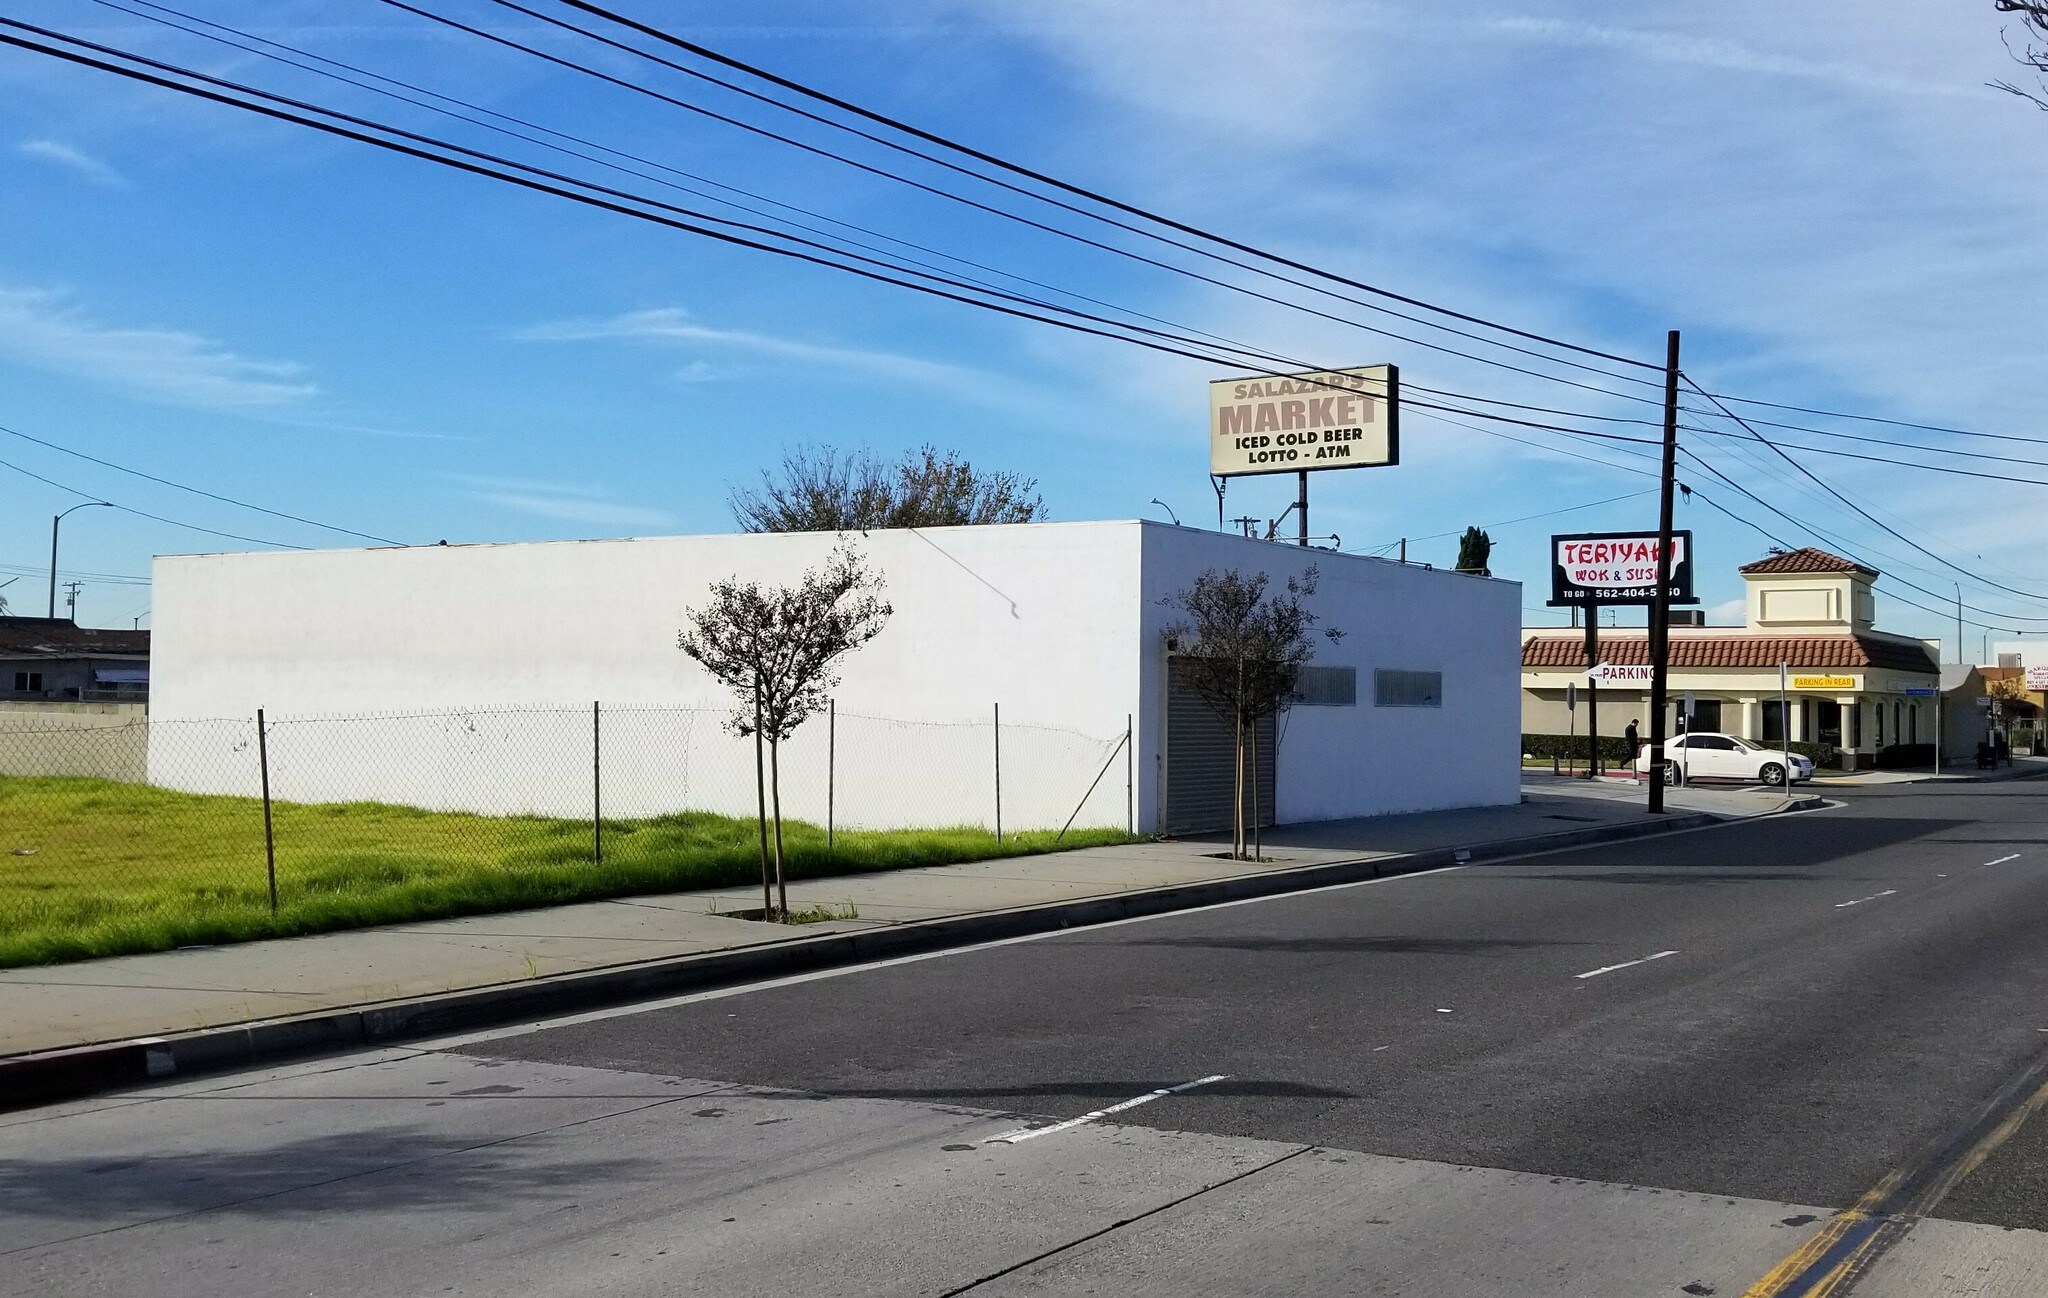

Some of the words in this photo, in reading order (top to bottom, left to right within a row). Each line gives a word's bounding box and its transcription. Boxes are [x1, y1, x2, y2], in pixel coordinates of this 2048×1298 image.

[1234, 373, 1365, 400] SALAZAR'S
[1219, 393, 1380, 435] MARKET
[1236, 435, 1270, 449] ICED
[1276, 432, 1318, 446] COLD
[1324, 428, 1363, 442] BEER
[1249, 449, 1298, 463] LOTTO
[1315, 444, 1350, 459] ATM
[1575, 569, 1609, 581] WOK
[1613, 570, 1621, 581] &
[1626, 568, 1660, 581] SUS
[1595, 588, 1680, 598] 562-404-50
[1795, 678, 1824, 686] PARKING
[1825, 678, 1832, 686] IN
[1834, 678, 1851, 686] REAR
